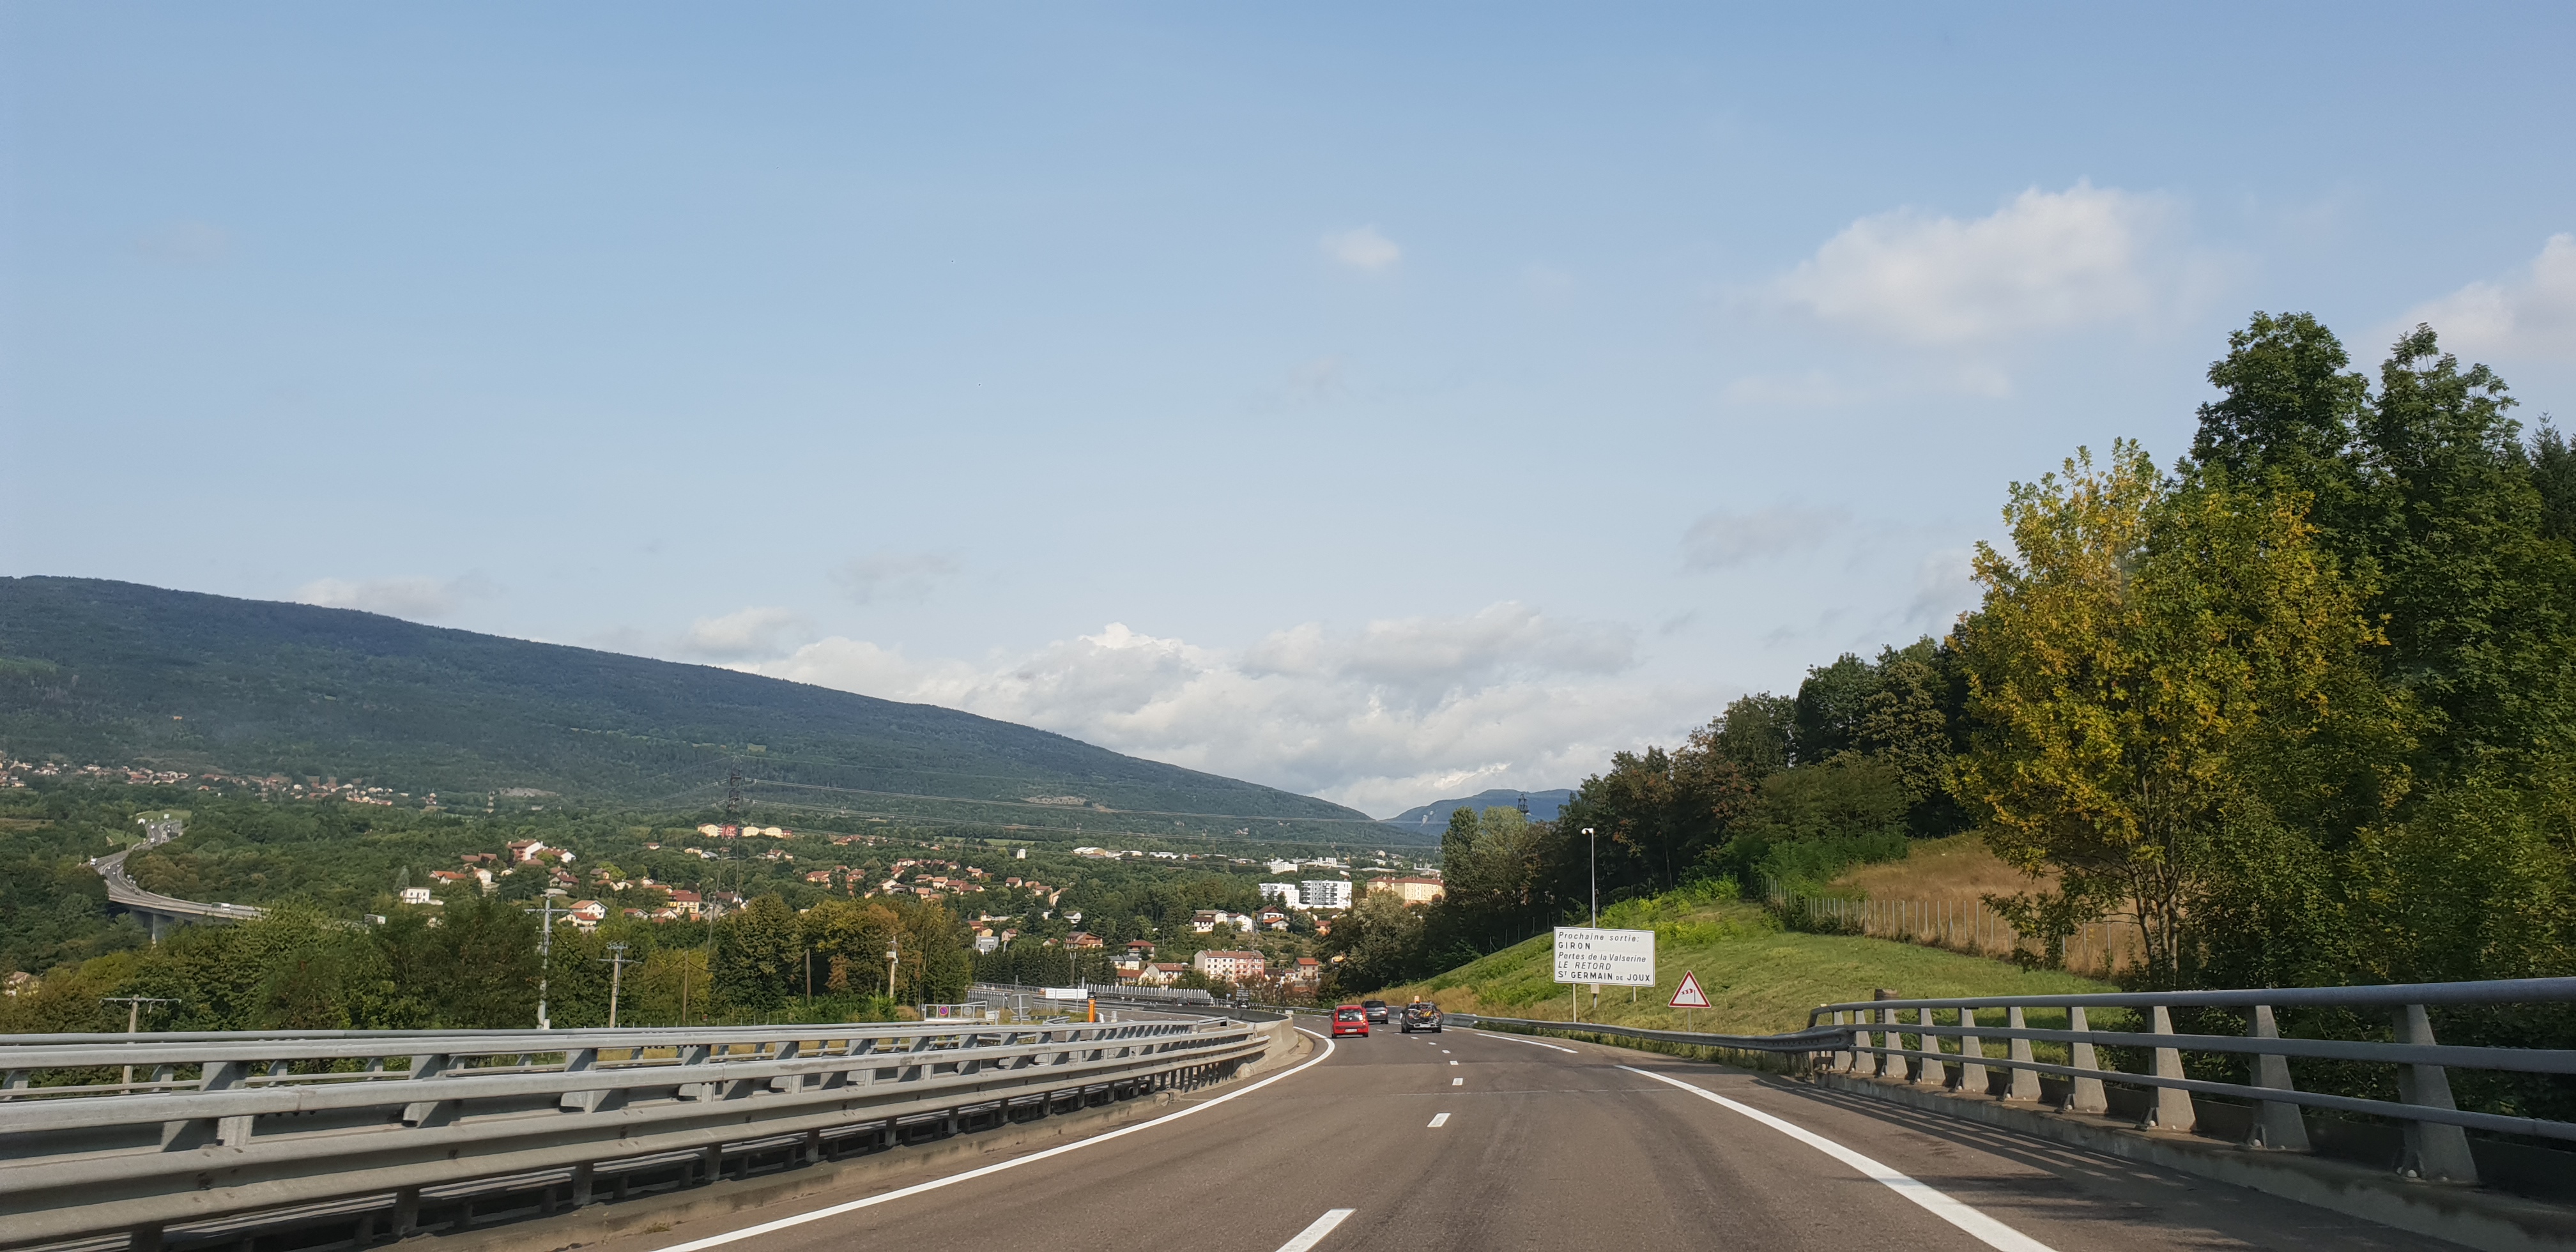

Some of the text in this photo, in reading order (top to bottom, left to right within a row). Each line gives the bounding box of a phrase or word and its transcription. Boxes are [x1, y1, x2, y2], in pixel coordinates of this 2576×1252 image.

[1558, 931, 1604, 940] Prochaine
[1558, 952, 1584, 960] Pertes
[1609, 954, 1646, 963] Valserine
[1575, 962, 1611, 970] RETORD
[1571, 972, 1613, 981] GERMAIN
